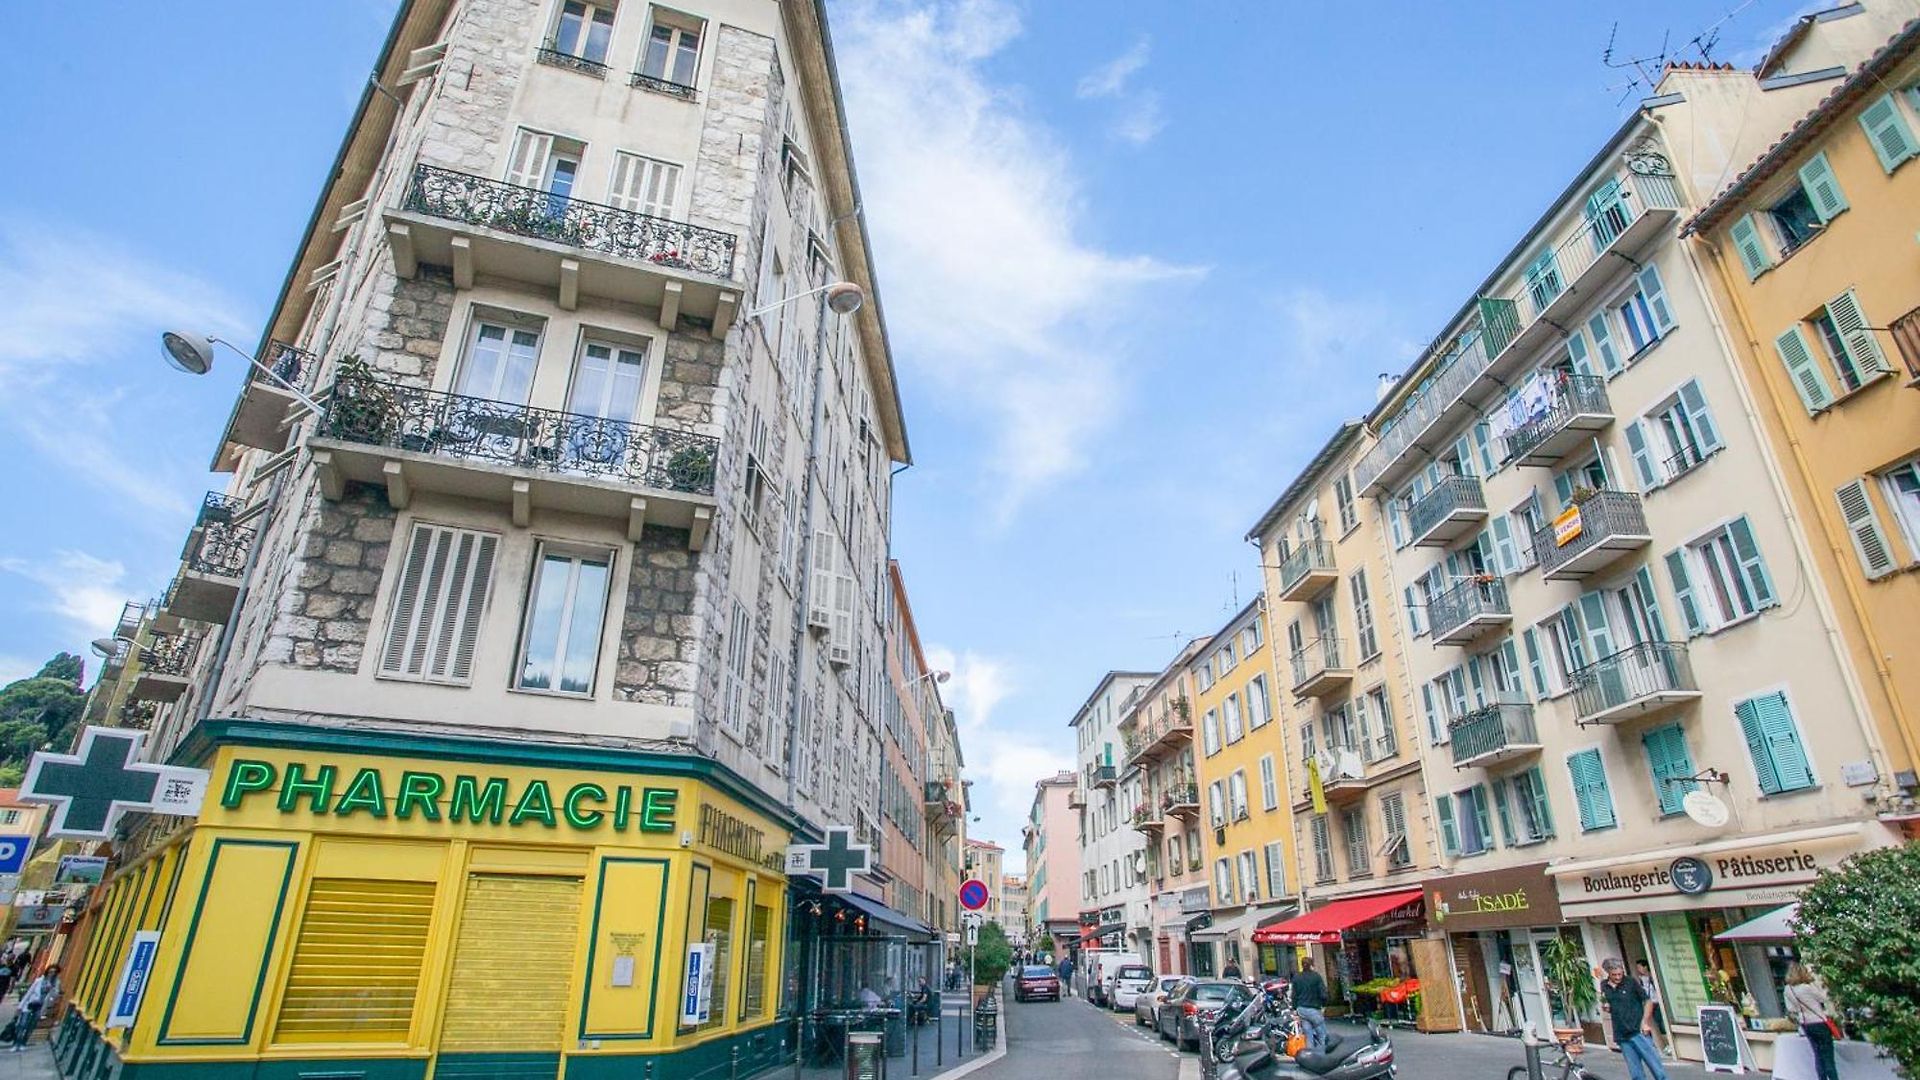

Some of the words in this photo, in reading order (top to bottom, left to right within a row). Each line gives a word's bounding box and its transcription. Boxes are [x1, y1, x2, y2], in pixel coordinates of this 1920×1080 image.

[221, 759, 679, 833] PHARMACIE
[698, 803, 765, 865] PHARMACIE
[1583, 868, 1670, 893] Boulangerie
[1717, 849, 1816, 879] Pâtisserie
